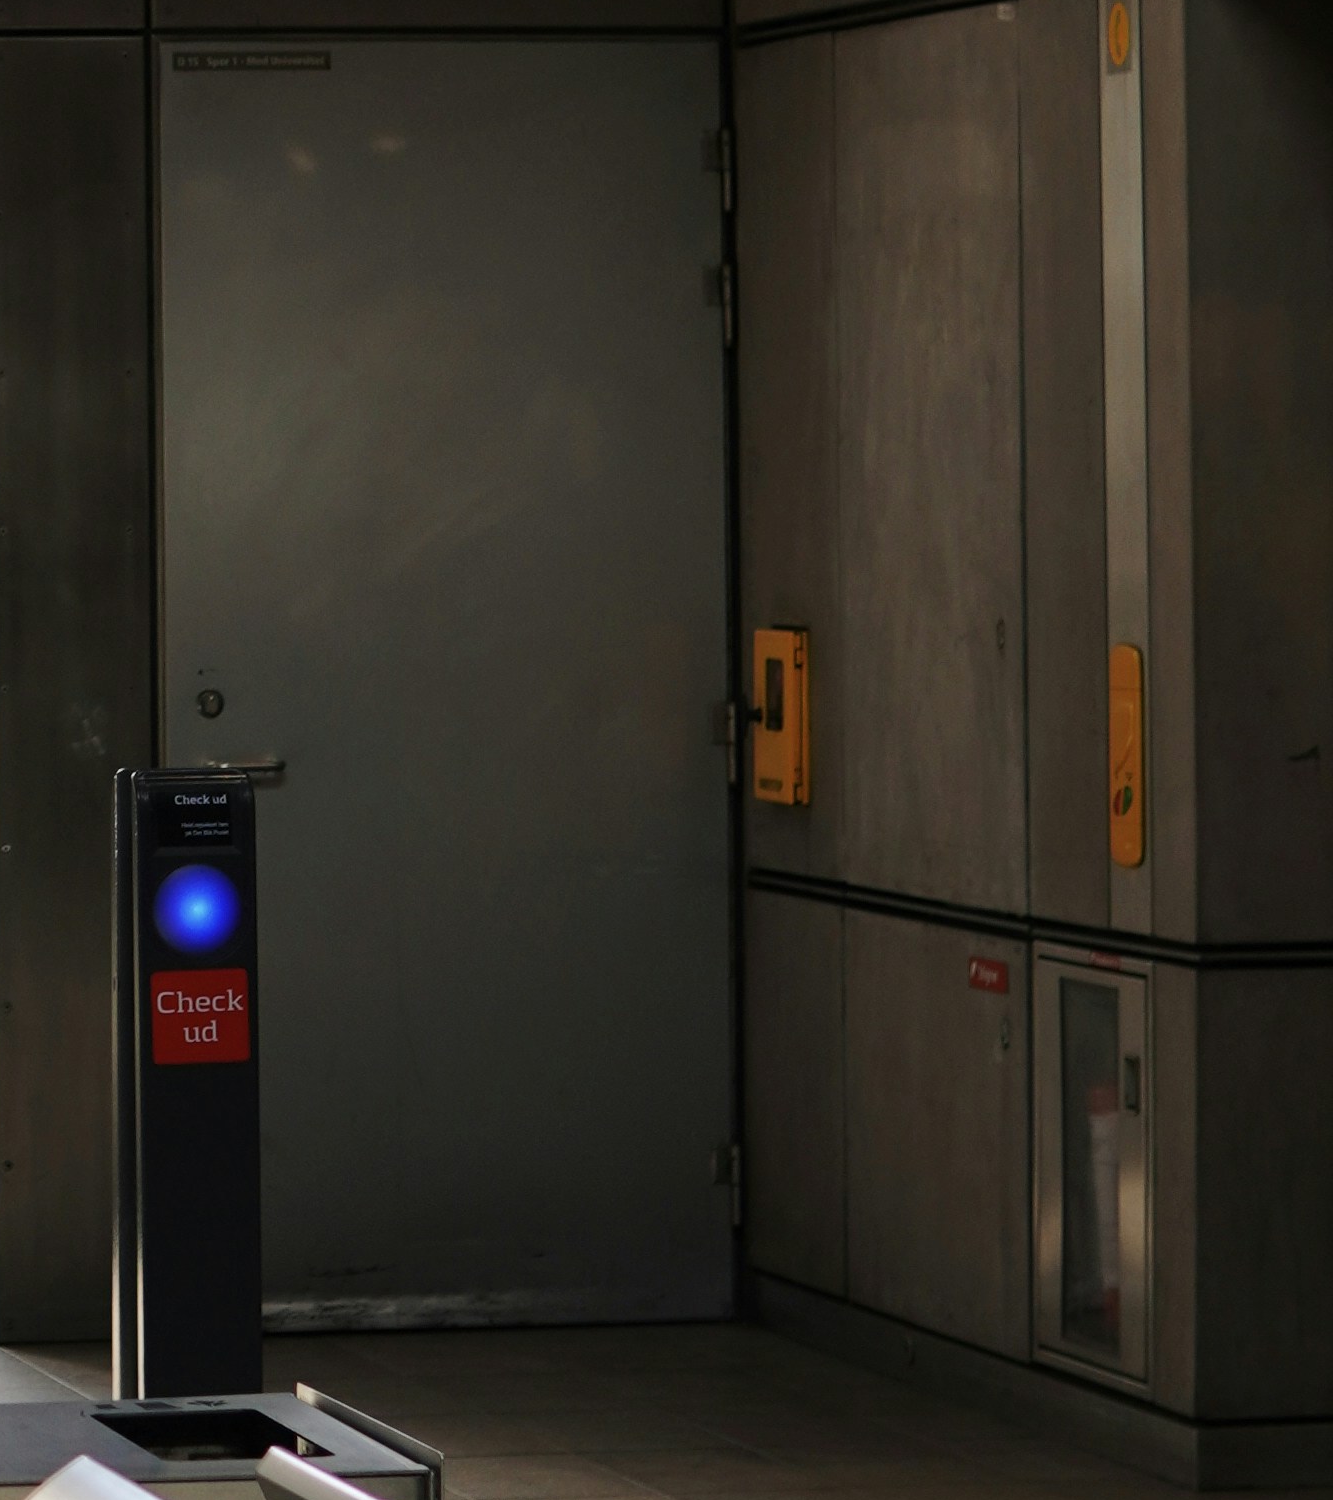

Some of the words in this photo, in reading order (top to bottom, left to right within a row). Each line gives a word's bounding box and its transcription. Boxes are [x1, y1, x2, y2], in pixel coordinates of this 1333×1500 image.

[173, 794, 211, 806] Check
[212, 793, 228, 805] ud
[156, 988, 244, 1014] Check
[183, 1020, 219, 1044] ud
